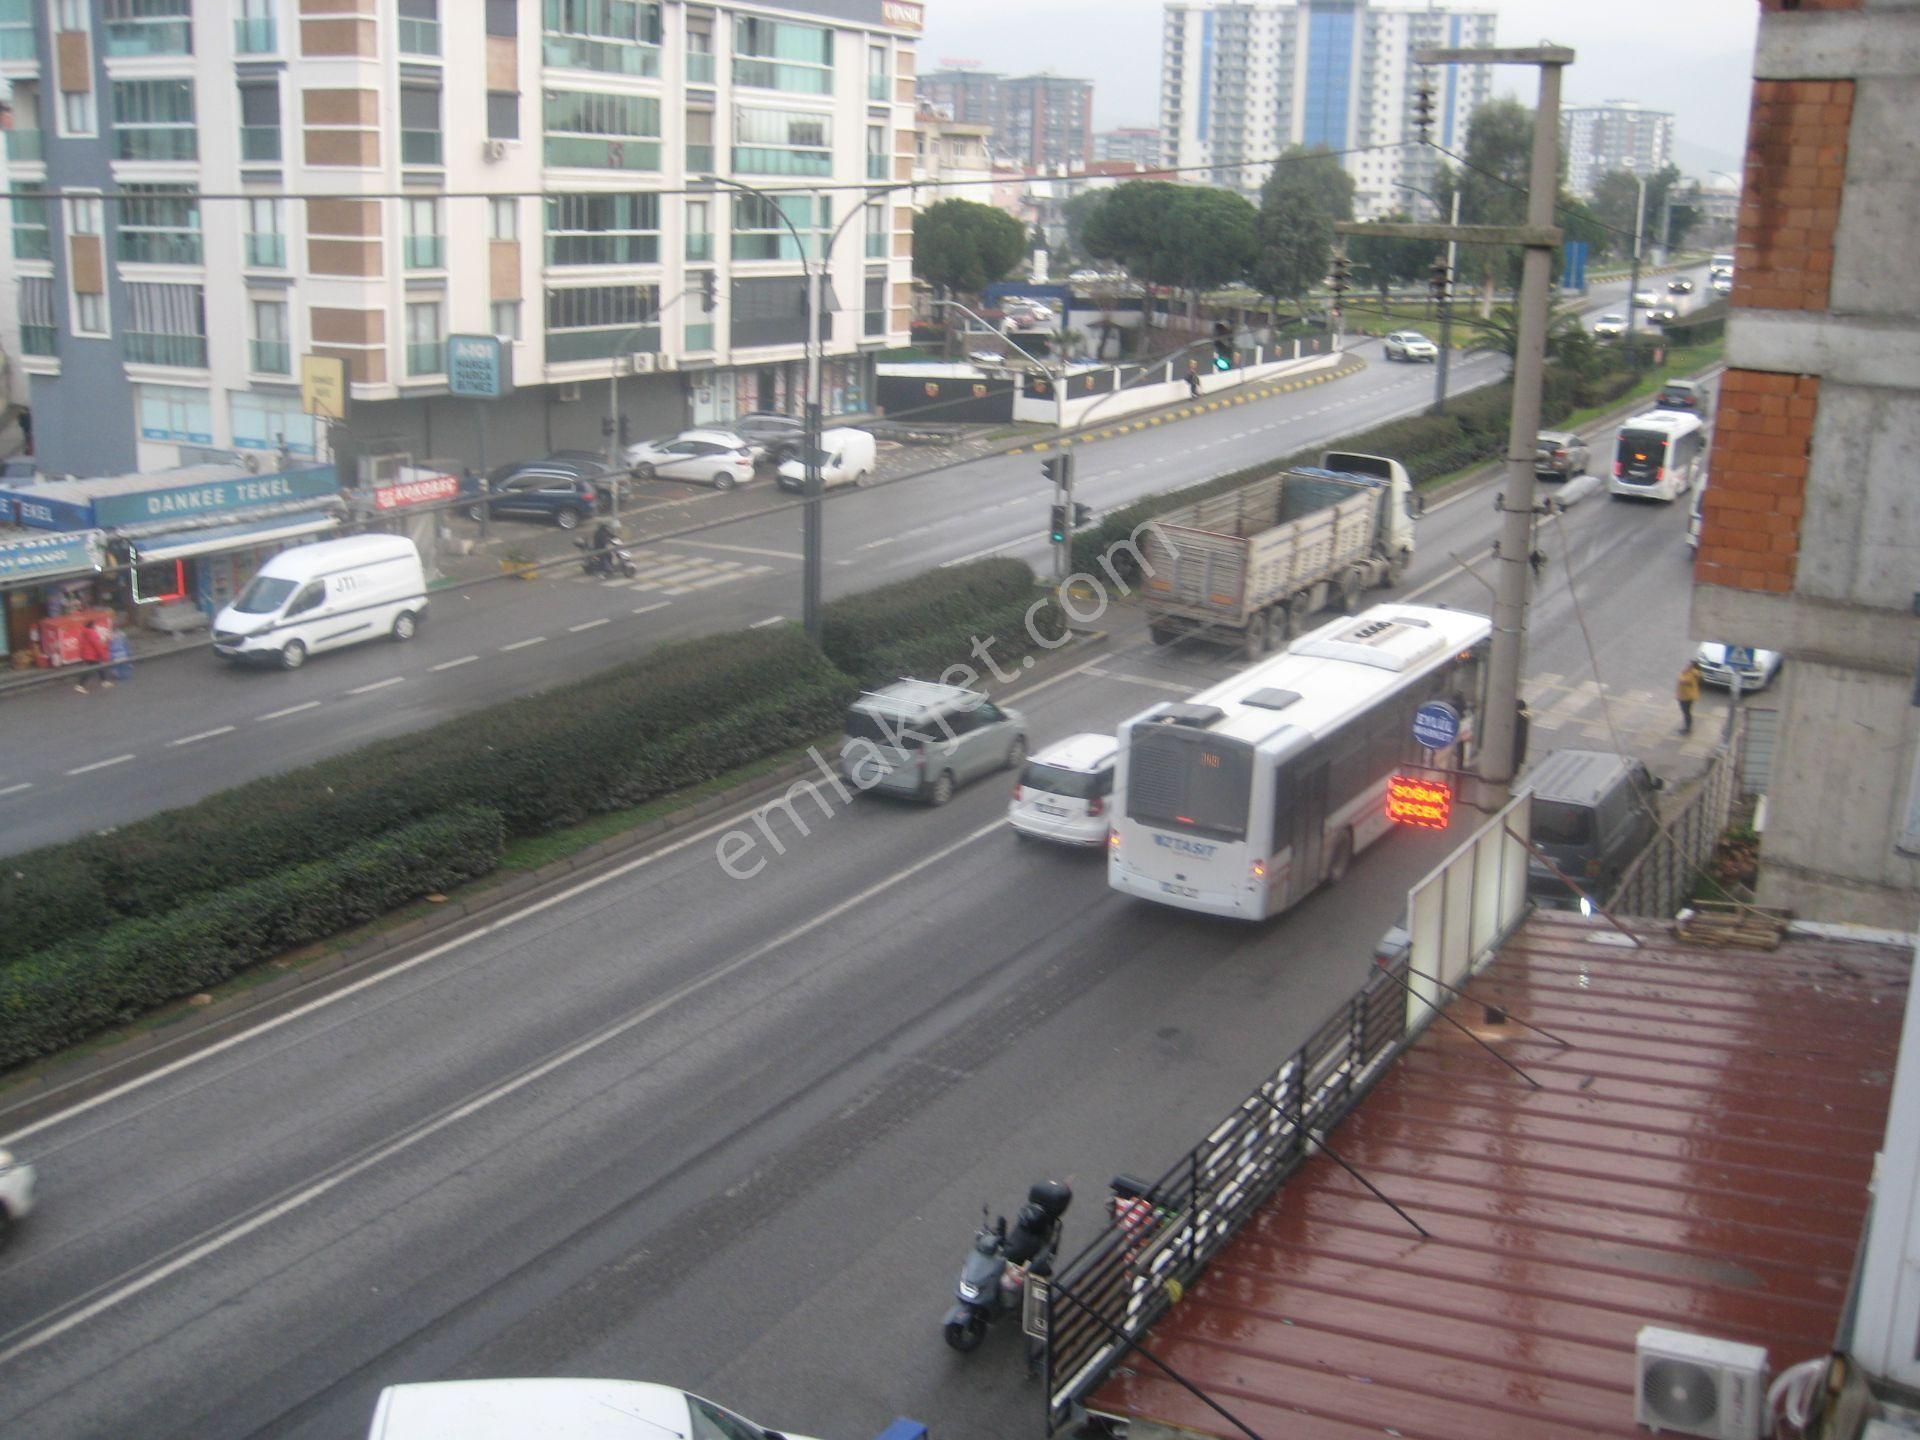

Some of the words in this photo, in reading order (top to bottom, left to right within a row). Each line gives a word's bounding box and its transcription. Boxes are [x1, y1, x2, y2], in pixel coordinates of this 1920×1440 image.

[18, 500, 54, 522] EKEL
[147, 488, 225, 515] DANKEE
[236, 478, 293, 501] TEKEL
